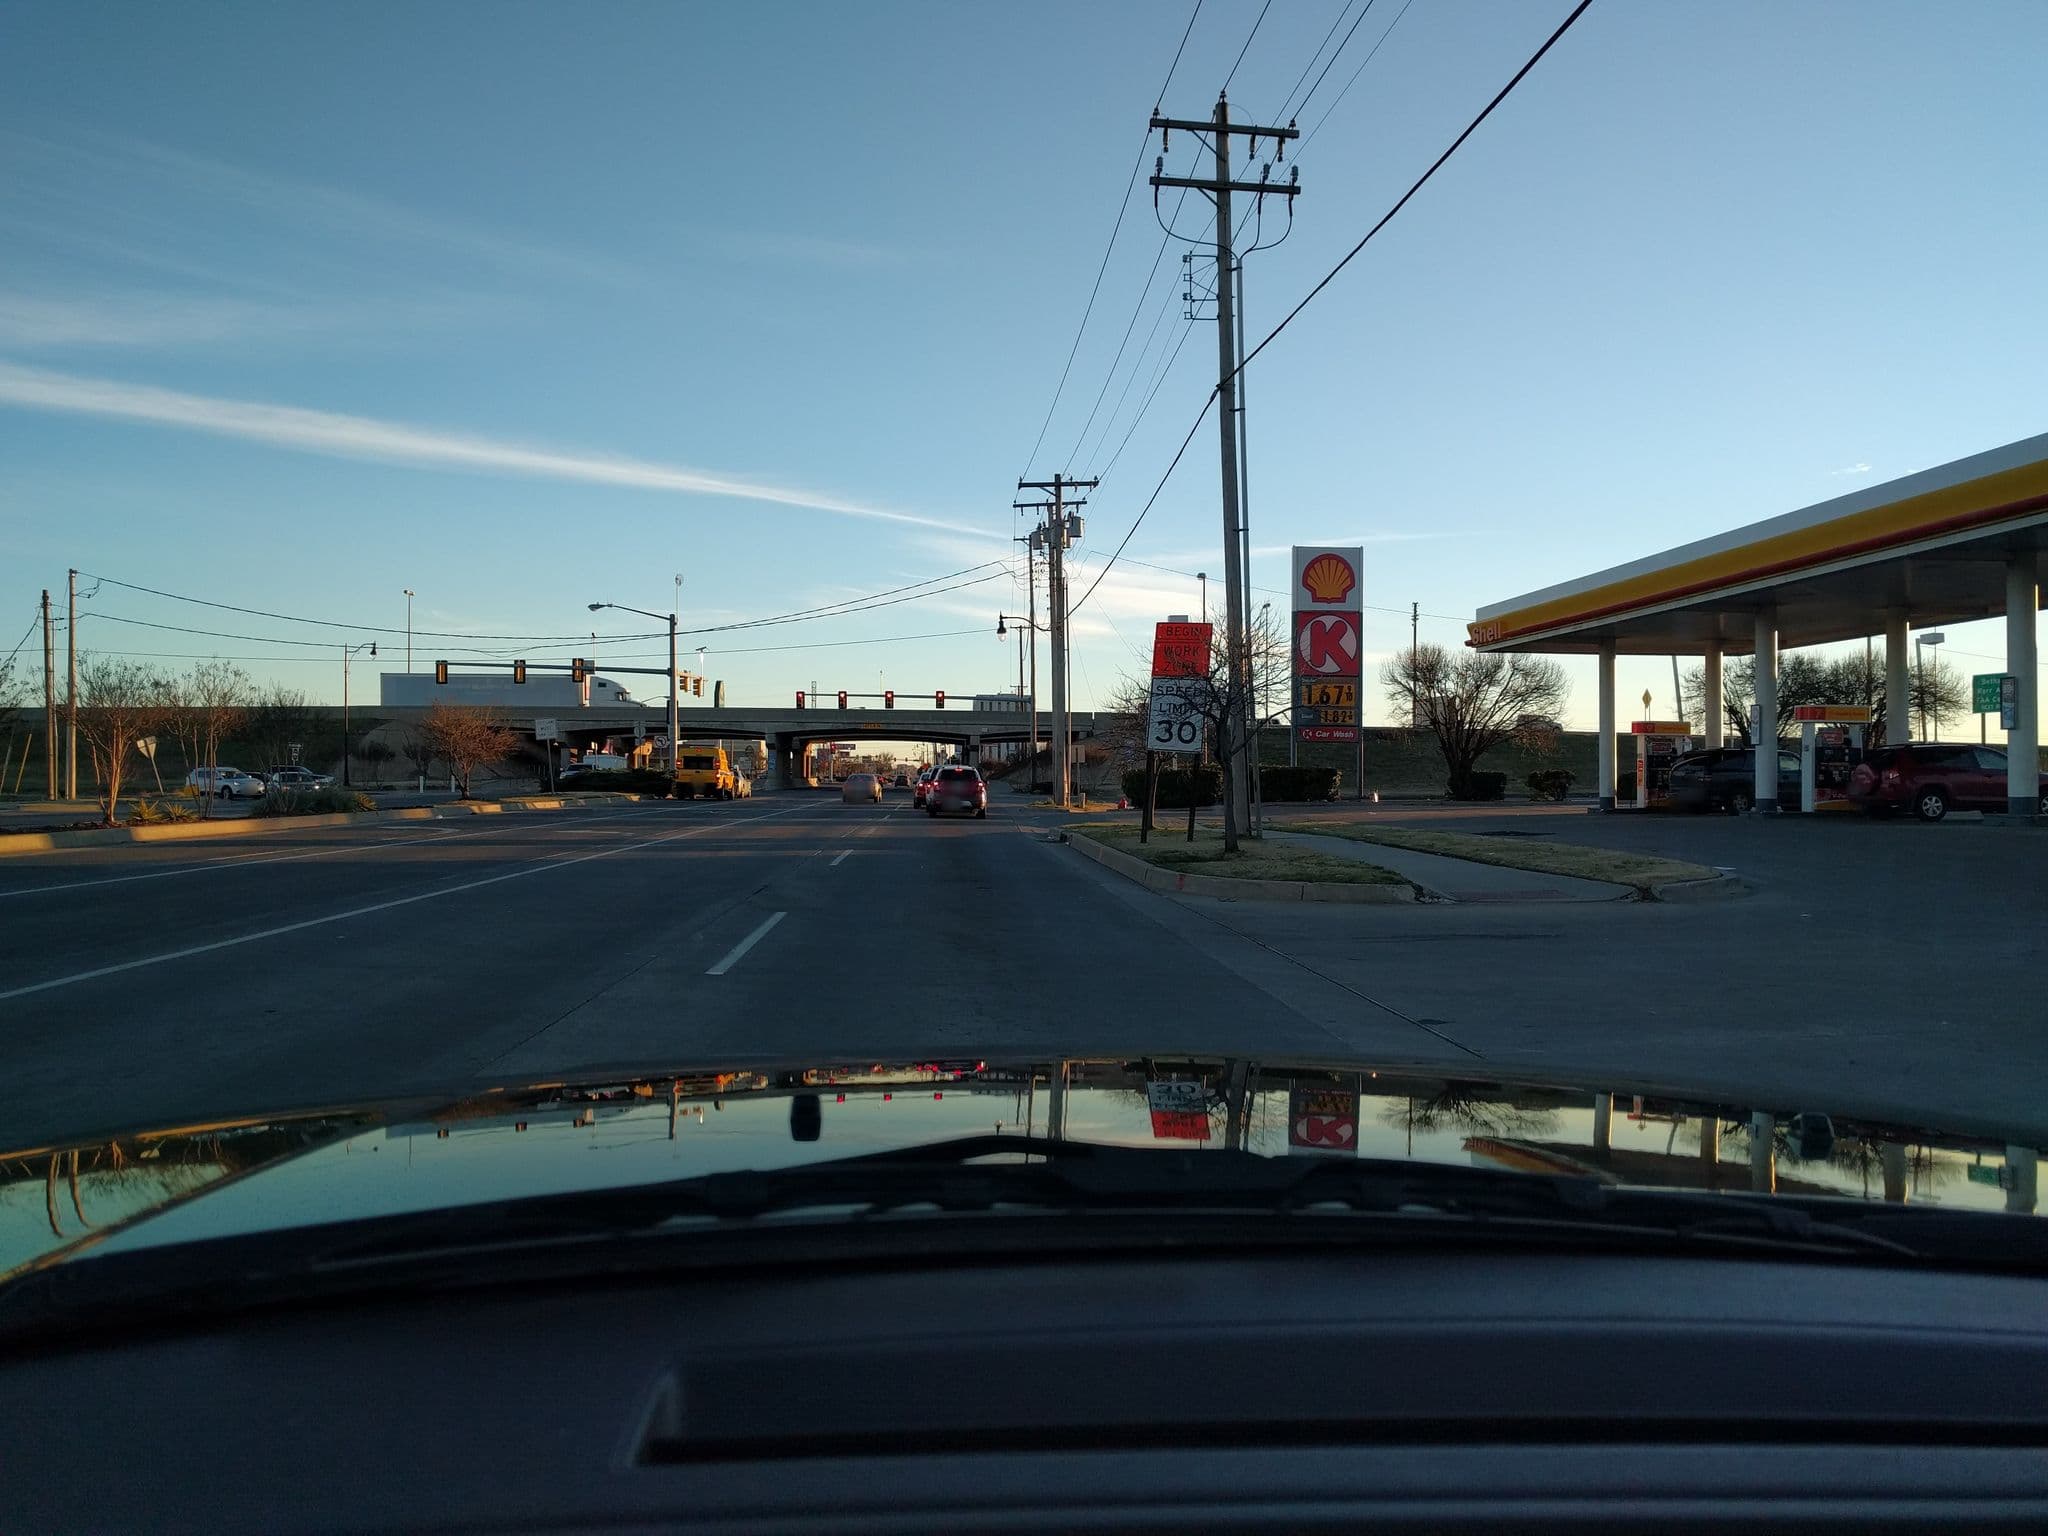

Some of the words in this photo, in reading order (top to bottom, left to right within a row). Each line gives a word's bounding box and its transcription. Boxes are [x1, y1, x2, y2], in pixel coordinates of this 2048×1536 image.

[1166, 626, 1202, 637] BEGIN
[1472, 622, 1501, 645] Shell
[1164, 645, 1200, 657] WORK
[1309, 620, 1354, 673] K
[1156, 685, 1202, 697] SPEED
[1155, 720, 1197, 744] 30
[1315, 730, 1330, 738] Car
[1333, 730, 1354, 738] Wash
